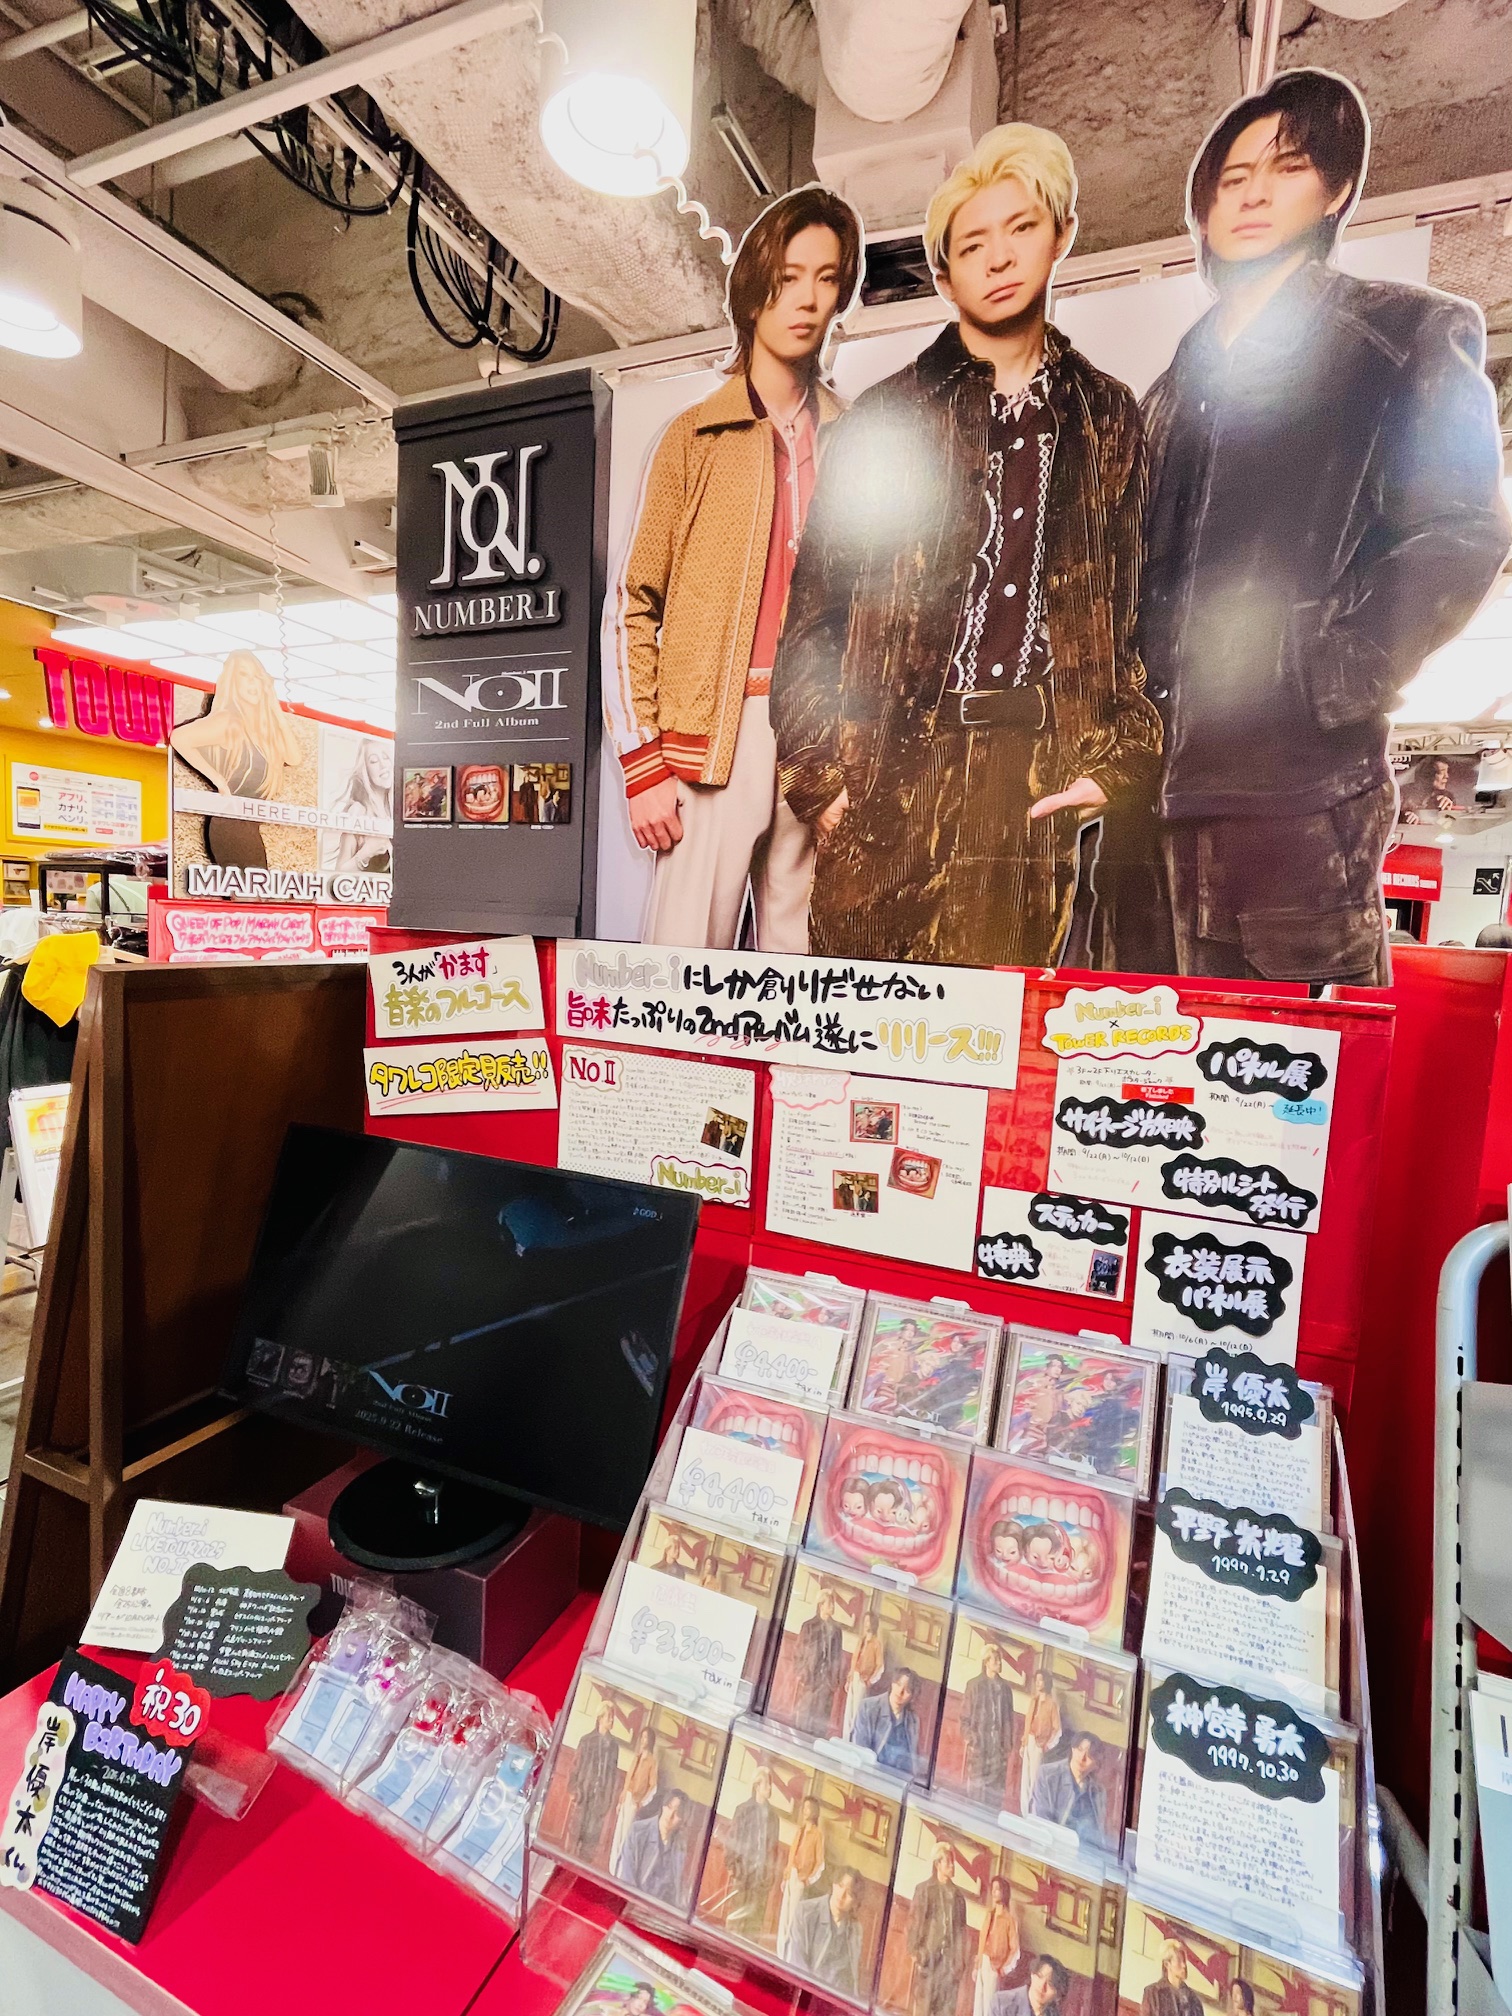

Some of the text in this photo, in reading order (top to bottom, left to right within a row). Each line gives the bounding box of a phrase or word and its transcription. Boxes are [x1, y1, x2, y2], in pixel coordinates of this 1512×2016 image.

[435, 716, 539, 730] 2nd Full Album
[243, 802, 380, 832] HERE FOR IT ALL
[190, 865, 325, 899] MARIAH
[383, 980, 532, 1028] 音楽のフルコース
[1050, 1025, 1192, 1052] TOWER RECORDS
[1210, 1047, 1314, 1091] パネル展
[1035, 1203, 1115, 1233] ステッカー
[978, 1238, 1034, 1274] 特典
[1163, 1245, 1276, 1284] 衣装展示
[1182, 1284, 1270, 1319] パネル展
[1220, 1401, 1287, 1427] 1995.9.29
[1211, 1554, 1290, 1585] 1997.1.29
[64, 1671, 126, 1724] HAPPY
[1165, 1689, 1249, 1746] 神宮寺
[1207, 1745, 1299, 1782] 1997.10.30
